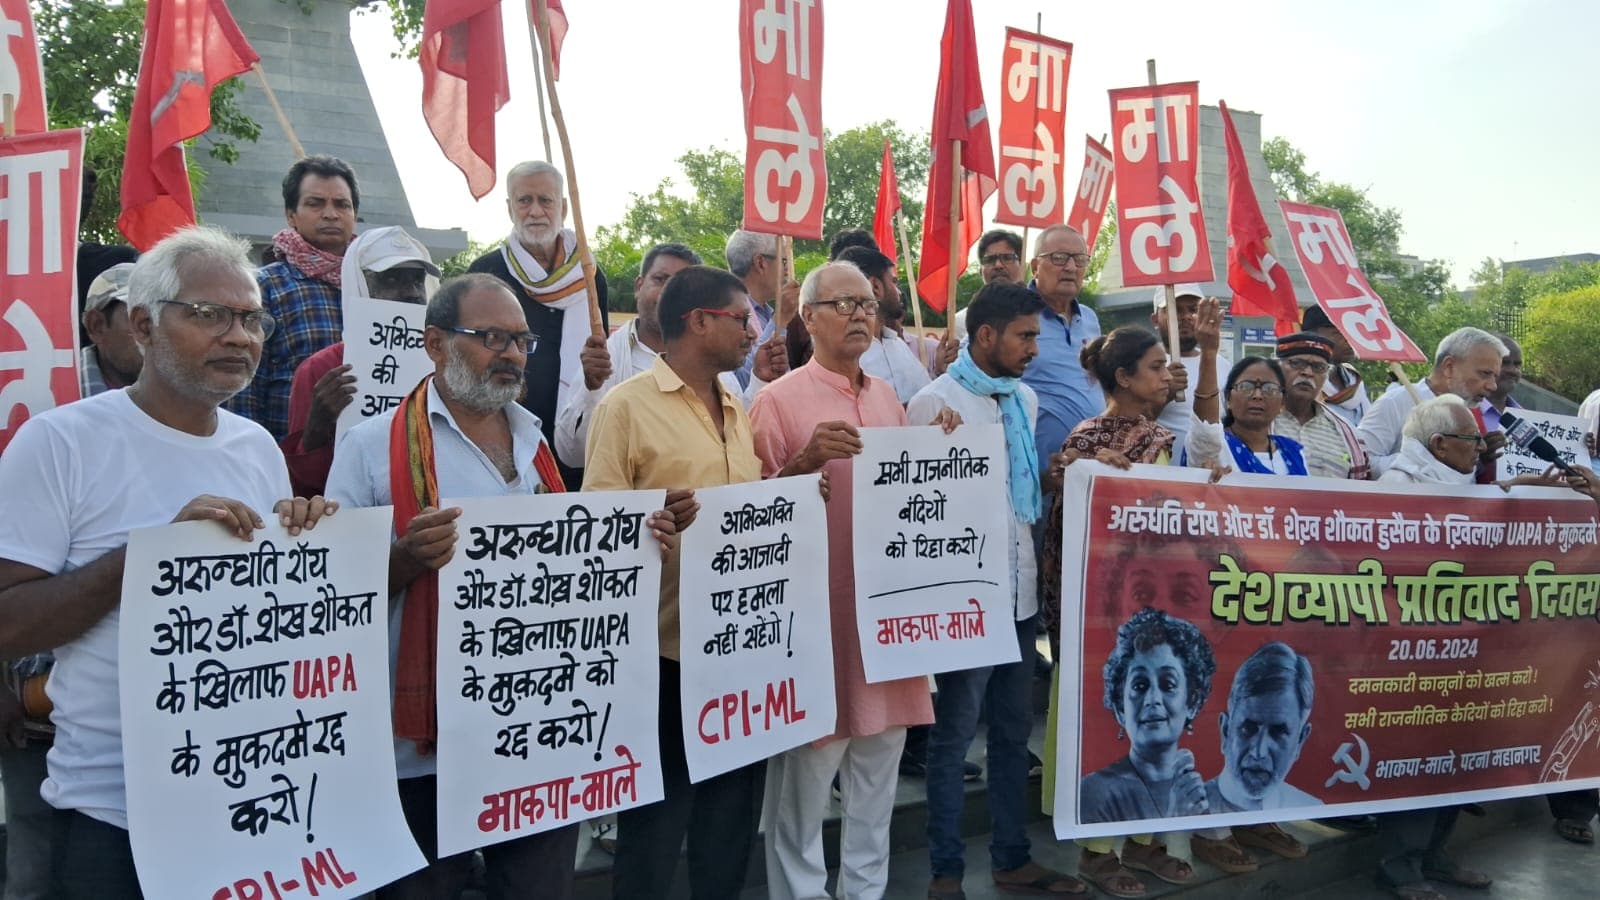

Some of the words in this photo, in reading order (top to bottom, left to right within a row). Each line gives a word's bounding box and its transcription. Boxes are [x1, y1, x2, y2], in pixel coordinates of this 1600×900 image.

[372, 354, 400, 385] की
[874, 450, 912, 486] सभी
[912, 447, 989, 484] राजनीतिक
[721, 496, 796, 536] अभिव्यक्ति
[899, 489, 947, 525] बंदियों
[1107, 499, 1184, 535] अरुंधति
[1185, 501, 1219, 536] रॉय
[1222, 503, 1254, 538] और
[1255, 506, 1280, 540] डॉ.
[1283, 507, 1321, 545] शेख़
[1324, 509, 1374, 544] शौकत
[1375, 511, 1420, 549] हुसैन
[1422, 513, 1441, 545] के
[1443, 514, 1505, 549] ख़िलाफ़
[1506, 522, 1542, 545] UAPA
[1544, 515, 1557, 545] के
[1557, 516, 1598, 552] मुक़दमे
[465, 504, 599, 561] अरुन्धति
[597, 506, 646, 553] रॉय
[711, 544, 737, 576] की
[737, 532, 792, 571] आजादी
[886, 532, 906, 559] को
[912, 533, 945, 558] रिहा
[151, 540, 286, 597] अरुन्धति
[285, 541, 330, 583] रॉय
[454, 568, 498, 610] और
[499, 572, 527, 610] डॉ.
[576, 556, 644, 603] शौकत
[1208, 554, 1388, 626] देशव्यापी
[1392, 559, 1521, 626] प्रतिवाद
[1523, 560, 1600, 620] दिवस
[150, 605, 213, 655] और
[215, 604, 253, 651] डॉ.
[253, 591, 309, 644] शेख
[309, 583, 378, 636] शौकत
[711, 590, 734, 617] पर
[737, 578, 789, 616] हमला
[459, 620, 485, 658] के
[580, 611, 630, 651] UAPA
[704, 622, 738, 657] नहीं
[877, 598, 986, 645] भाकपा-माले
[1388, 638, 1479, 661] 20.06.2024
[156, 662, 187, 715] के
[190, 658, 289, 711] खिलाफ
[292, 653, 357, 700] UAPA
[461, 665, 485, 702] के
[585, 650, 619, 687] को
[1349, 672, 1416, 694] दमनकारी
[1418, 669, 1464, 697] कानूनों
[1466, 669, 1482, 689] को
[1484, 671, 1511, 688] खत्म
[698, 677, 806, 744] CPI-ML
[1344, 706, 1376, 729] सभी
[1378, 704, 1449, 728] राजनीतिक
[1490, 700, 1506, 719] को
[1507, 697, 1526, 718] रिहा
[171, 729, 201, 778] के
[213, 709, 313, 789] मुकदमे
[312, 711, 348, 756] रद्द
[494, 722, 532, 760] रद्द
[1375, 750, 1457, 779] भाकपा-माले,
[1460, 750, 1491, 771] पटना
[1492, 744, 1542, 768] महानगर
[477, 744, 642, 833] भाकपा-माले
